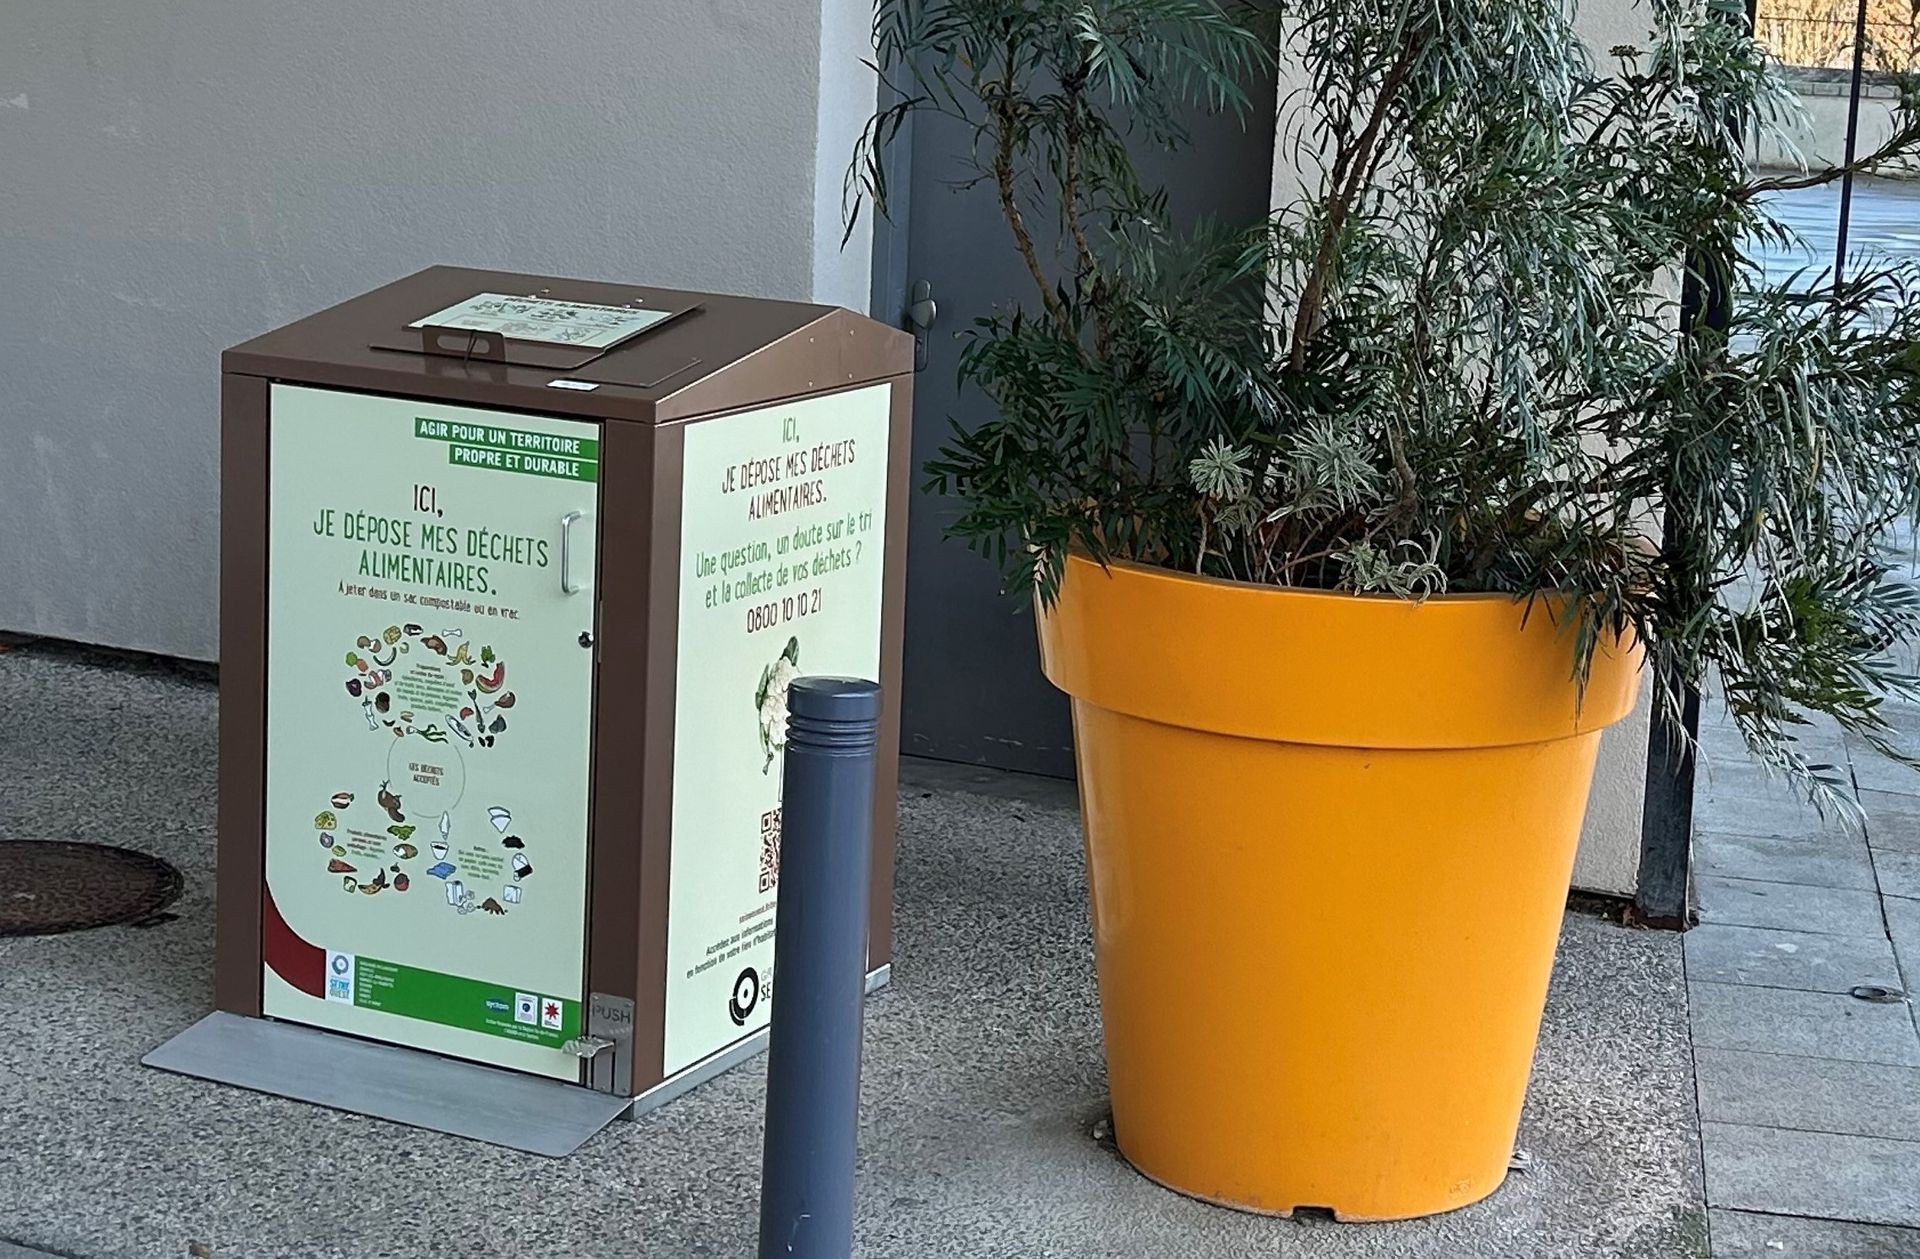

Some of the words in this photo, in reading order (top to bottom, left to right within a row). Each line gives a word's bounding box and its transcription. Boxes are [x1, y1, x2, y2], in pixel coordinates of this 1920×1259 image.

[420, 421, 448, 436] AGIR
[452, 424, 484, 443] POUR
[489, 429, 506, 445] UN
[510, 432, 579, 455] TERRITOIRE
[783, 417, 800, 443] ICI,
[455, 447, 501, 467] PROPRE
[505, 453, 520, 469] ET
[524, 456, 579, 477] DURABLE
[722, 466, 737, 494] JE
[740, 456, 783, 490] DÉPOSE
[786, 451, 807, 479] MES
[811, 439, 855, 473] DÉCHETS
[414, 484, 443, 518] ICI,
[749, 479, 827, 521] ALIMENTAIRES.
[314, 508, 335, 537] JE
[344, 511, 412, 548] DÉPOSE
[421, 523, 458, 554] MES
[467, 527, 549, 568] DÉCHETS
[695, 552, 717, 579] Une
[720, 541, 772, 576] question,
[777, 535, 789, 555] un
[793, 526, 822, 550] doute
[826, 519, 844, 542] sur
[847, 513, 855, 536] le
[859, 509, 873, 532] tri
[359, 549, 497, 595] ALIMENTAIRES.
[705, 584, 717, 609] et
[721, 579, 731, 603] la
[735, 570, 773, 600] collecte
[776, 563, 789, 588] de
[792, 559, 809, 581] vos
[812, 549, 852, 577] déchets
[855, 540, 863, 564] ?
[344, 583, 366, 596] jeter
[368, 586, 388, 600] dans
[390, 591, 401, 601] un
[404, 593, 417, 605] sac
[420, 595, 471, 612] compostable
[474, 604, 485, 615] ou
[487, 607, 498, 617] en
[747, 603, 778, 634] 0800
[782, 597, 794, 623] 10
[797, 592, 808, 618] 10
[811, 587, 822, 614] 21
[761, 982, 771, 1002] SE
[592, 1005, 631, 1025] PUSH
